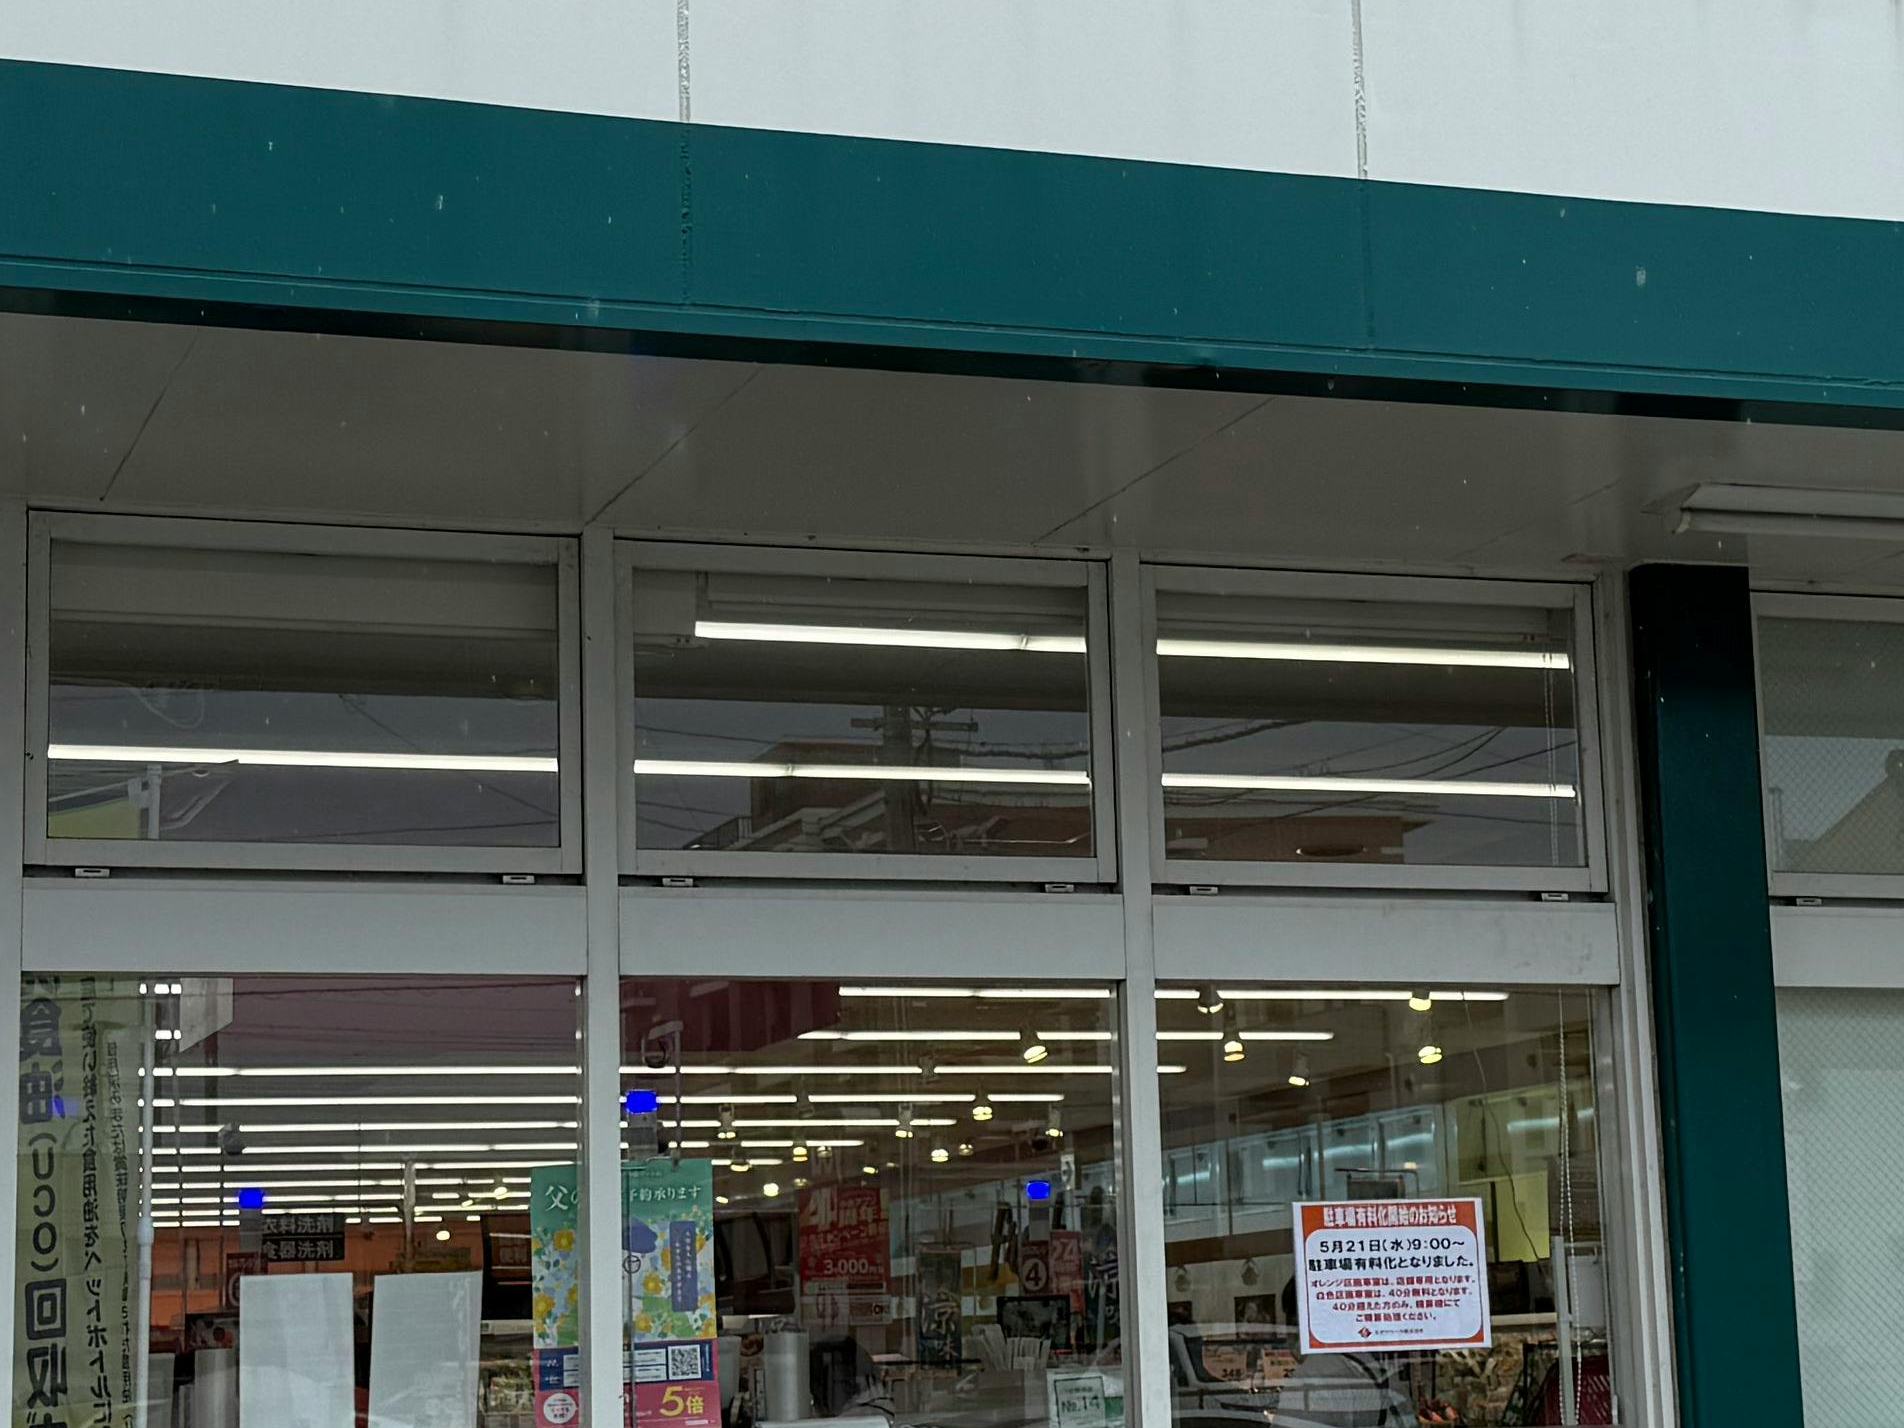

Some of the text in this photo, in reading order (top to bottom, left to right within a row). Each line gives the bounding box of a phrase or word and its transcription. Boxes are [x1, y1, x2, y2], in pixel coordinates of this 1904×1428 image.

[1323, 1204, 1457, 1227] 駐車場有料化開始のお知らせ
[1308, 1255, 1474, 1271] 駐車場有料化となりました。
[659, 1385, 705, 1417] 5倍
